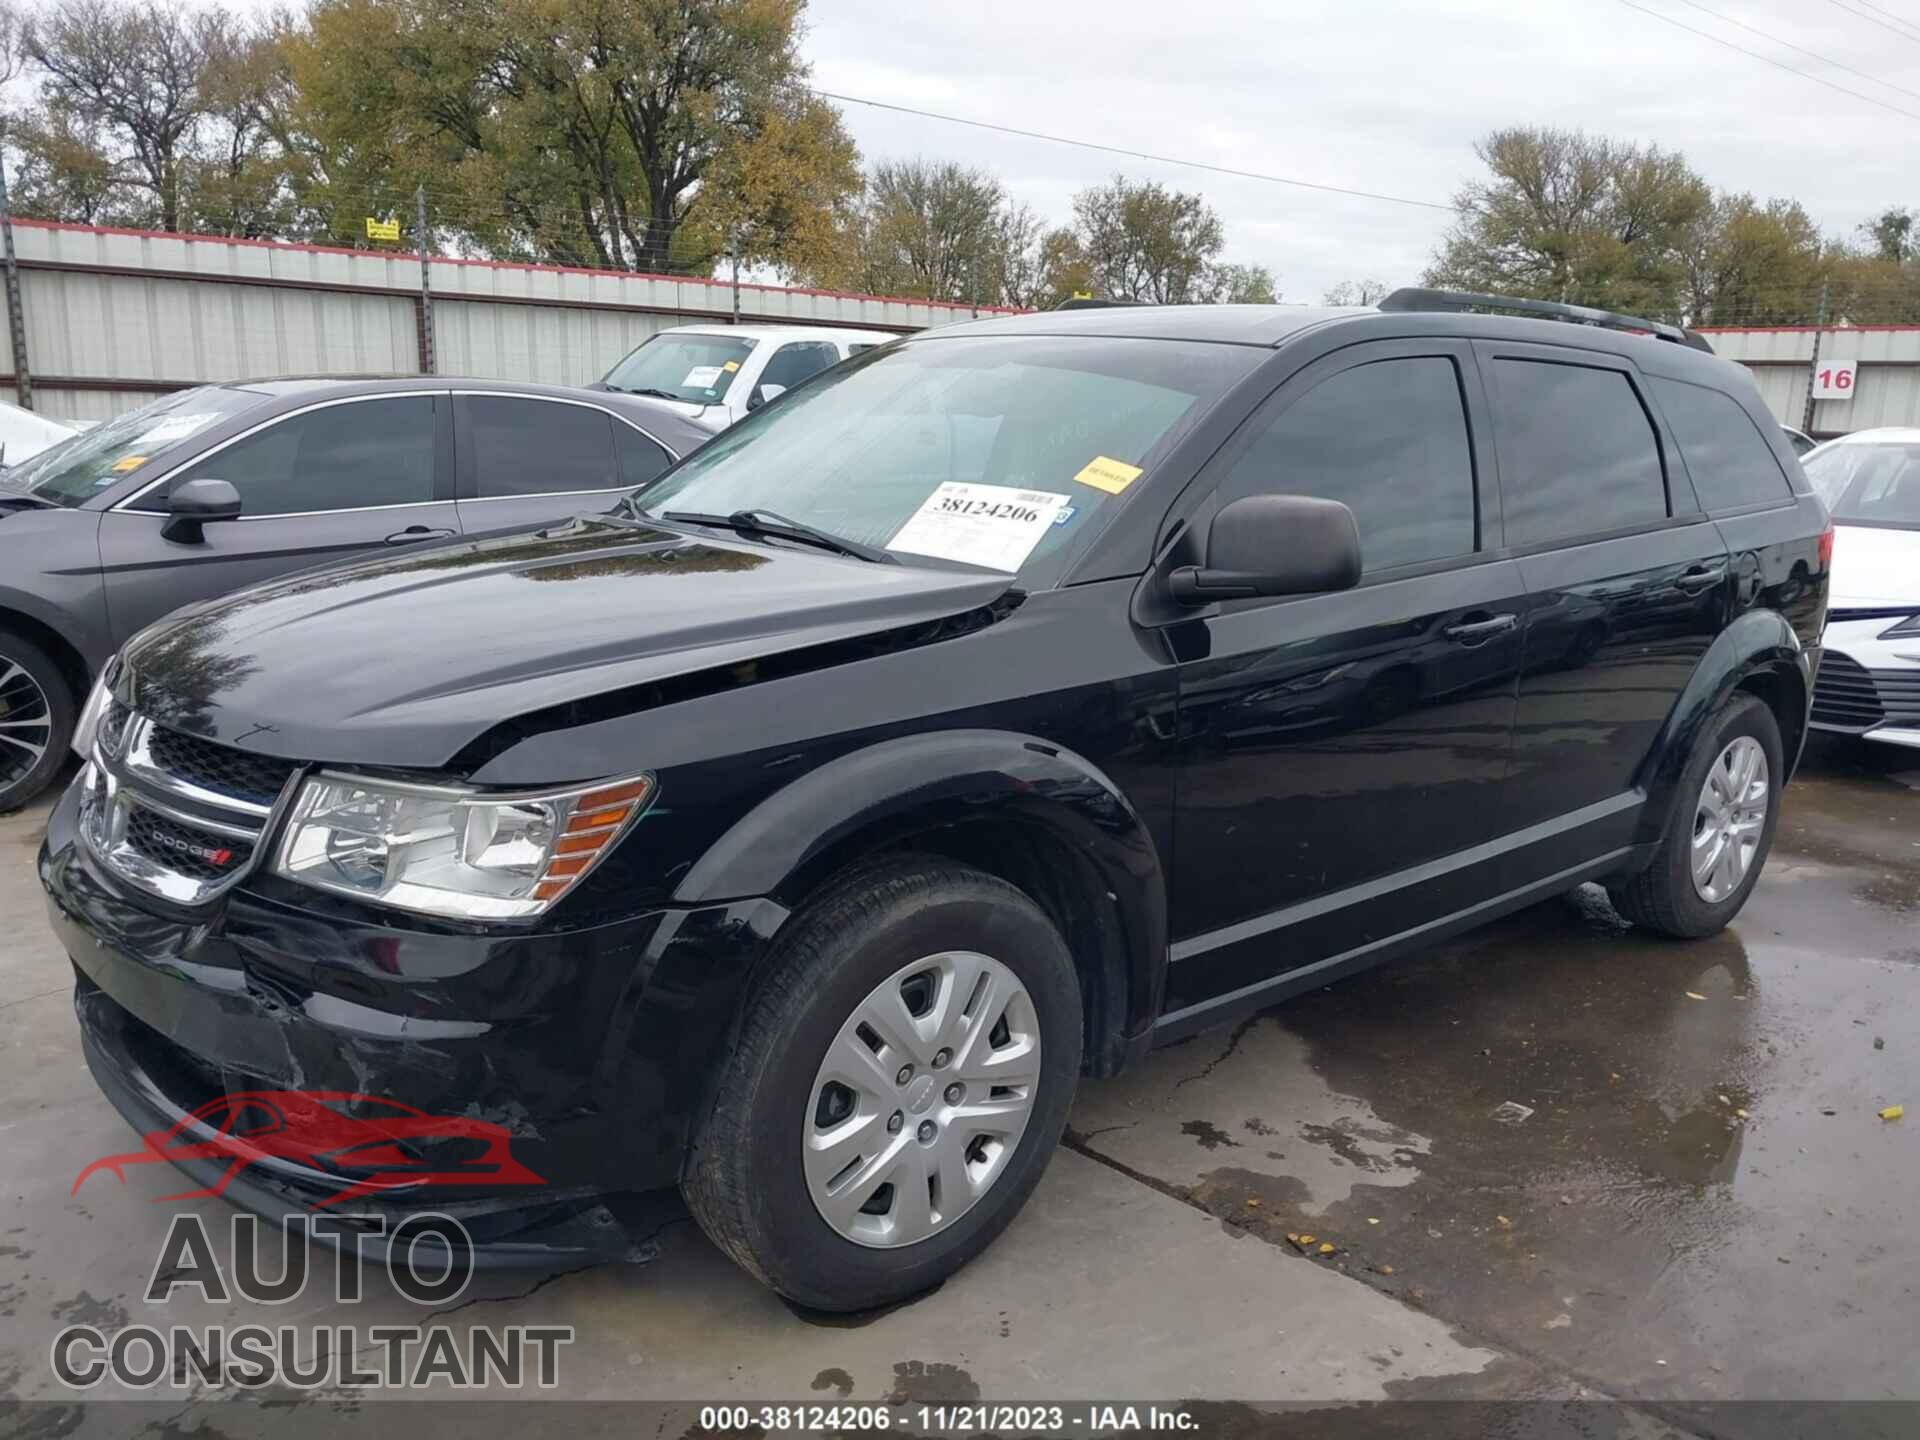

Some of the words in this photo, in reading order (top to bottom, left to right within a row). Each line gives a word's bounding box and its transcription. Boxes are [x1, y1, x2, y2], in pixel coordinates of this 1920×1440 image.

[1819, 369, 1852, 389] 16
[933, 498, 1038, 522] 38124206
[153, 830, 218, 860] DODGE
